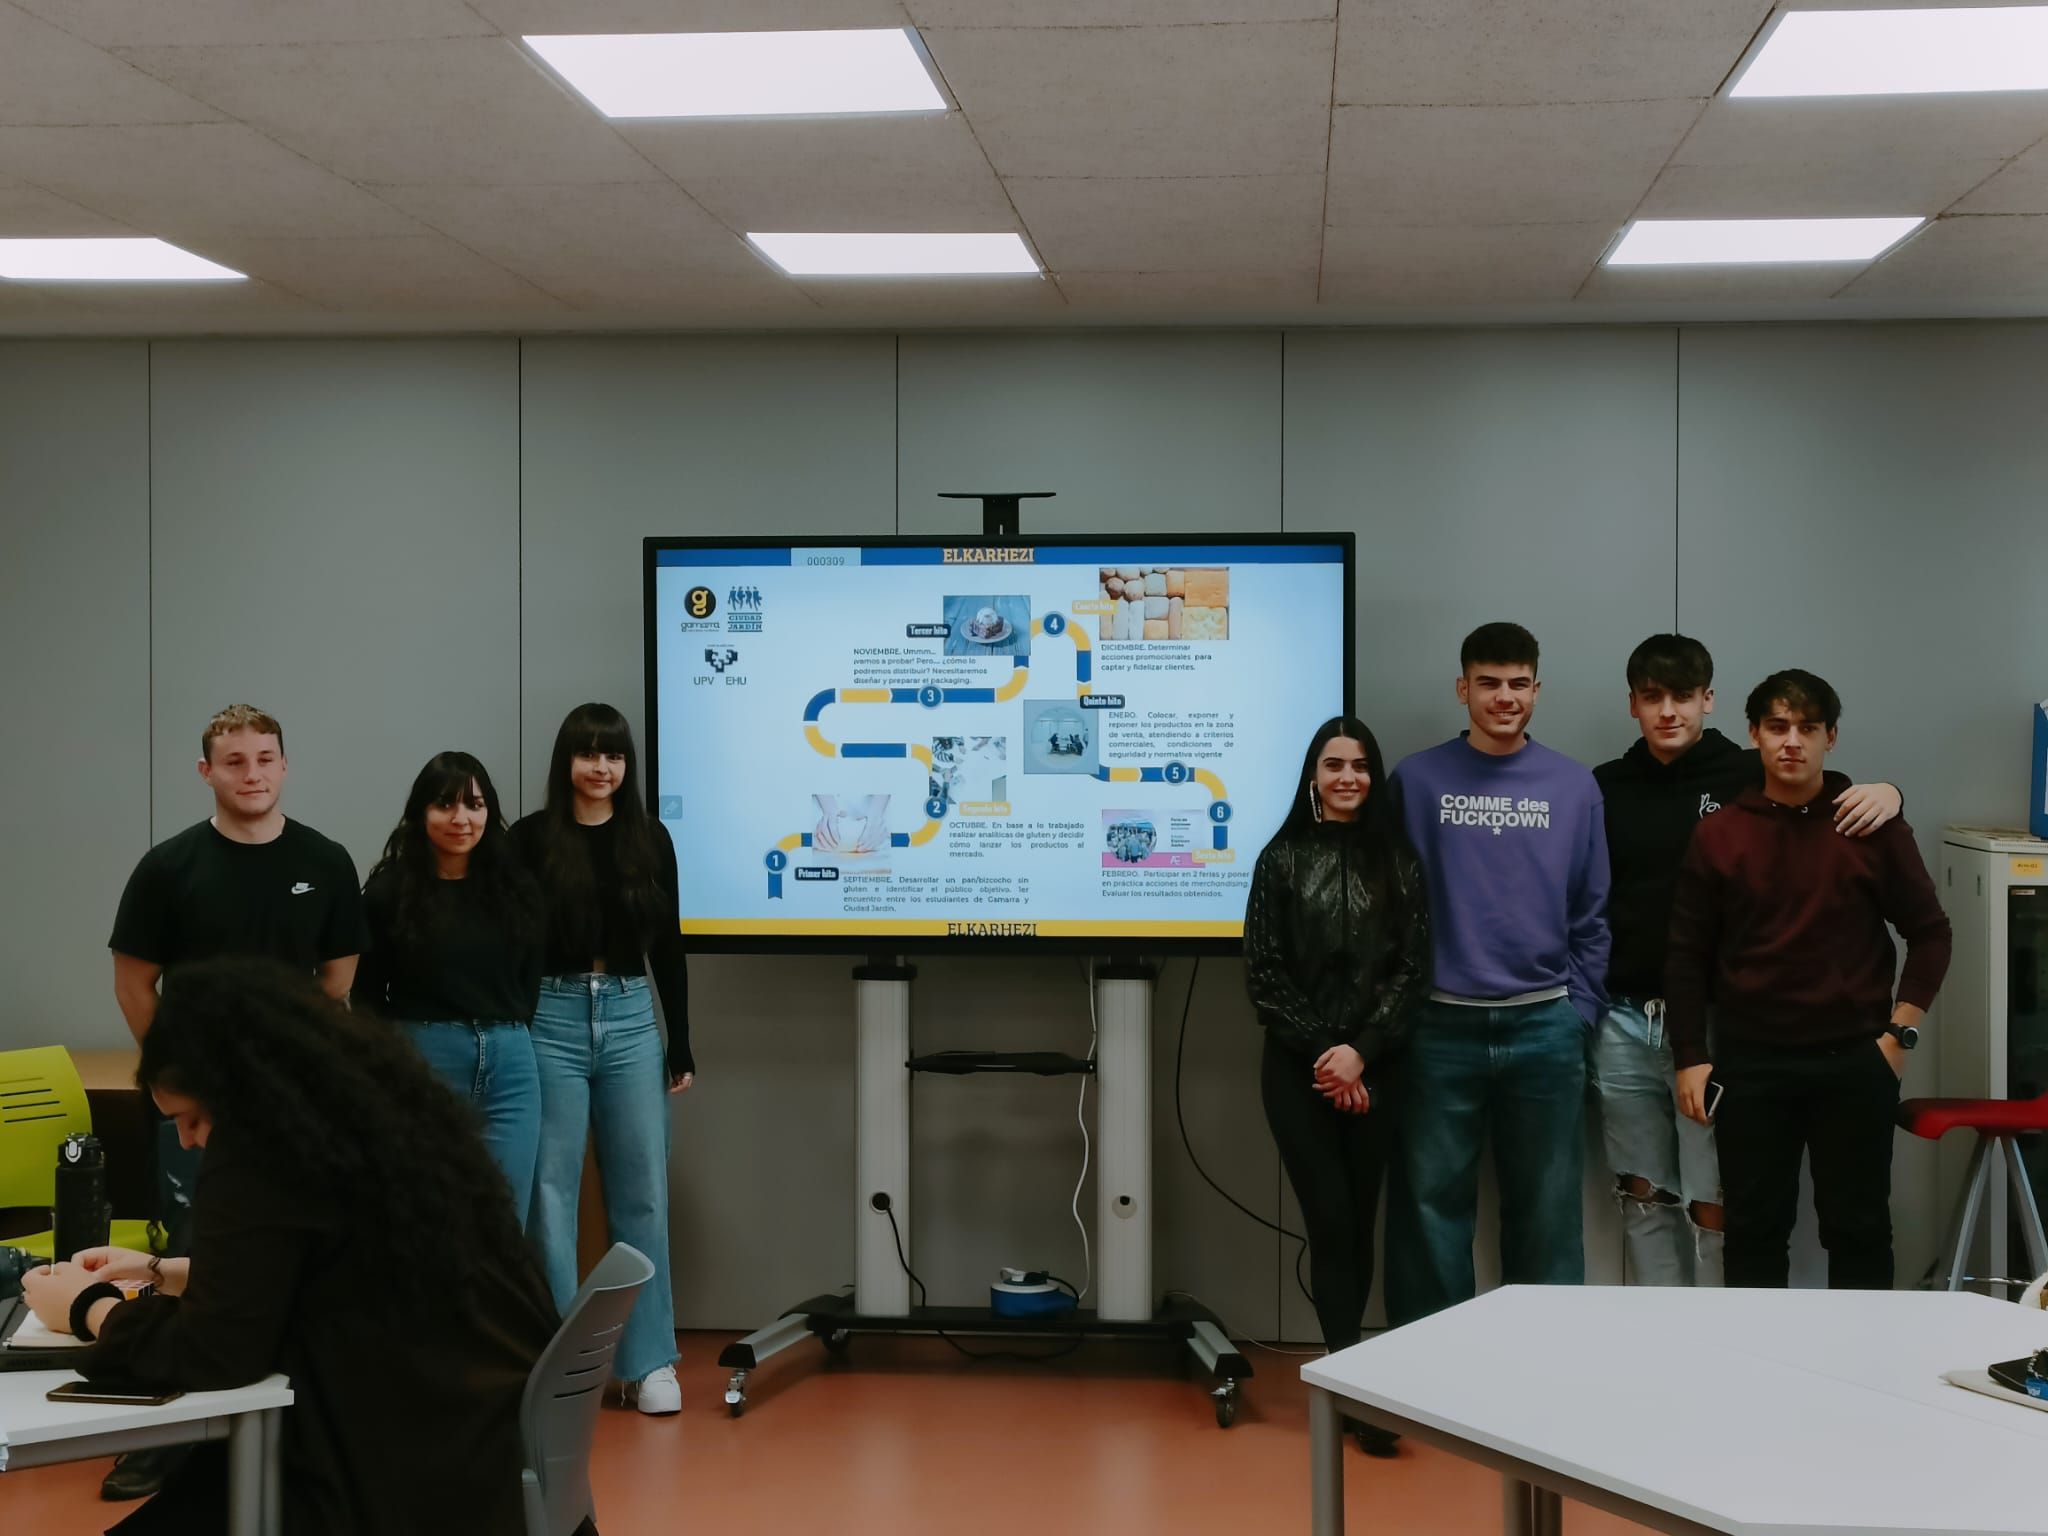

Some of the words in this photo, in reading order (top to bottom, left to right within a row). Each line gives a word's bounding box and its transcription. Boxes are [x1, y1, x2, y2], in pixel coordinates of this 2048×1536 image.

[942, 547, 1034, 563] ELKARHEZI
[807, 556, 845, 566] 000309
[1050, 618, 1058, 630] 4
[910, 625, 933, 636] Tercer
[1136, 654, 1191, 662] promocionales
[853, 668, 891, 676] podremos
[1101, 664, 1125, 672] captar
[693, 676, 715, 686] UPV
[725, 676, 747, 686] EHU
[926, 690, 934, 702] 3
[1083, 696, 1106, 706] Quinto
[1107, 696, 1121, 706] hito
[1108, 751, 1146, 759] seguridad
[1194, 751, 1223, 759] vigente
[1172, 768, 1179, 779] 5
[933, 802, 941, 813] 2
[1440, 794, 1512, 812] COMME
[1517, 798, 1550, 812] des
[1217, 806, 1224, 818] 6
[1440, 809, 1550, 829] FUCKDOWN
[1048, 822, 1084, 830] trabajado
[1030, 841, 1069, 849] productos
[772, 854, 779, 867] 1
[798, 869, 821, 878] Primer
[1144, 870, 1180, 878] Participar
[961, 876, 1012, 884] pan/bizcocho
[947, 923, 1037, 936] ELKARHEZI
